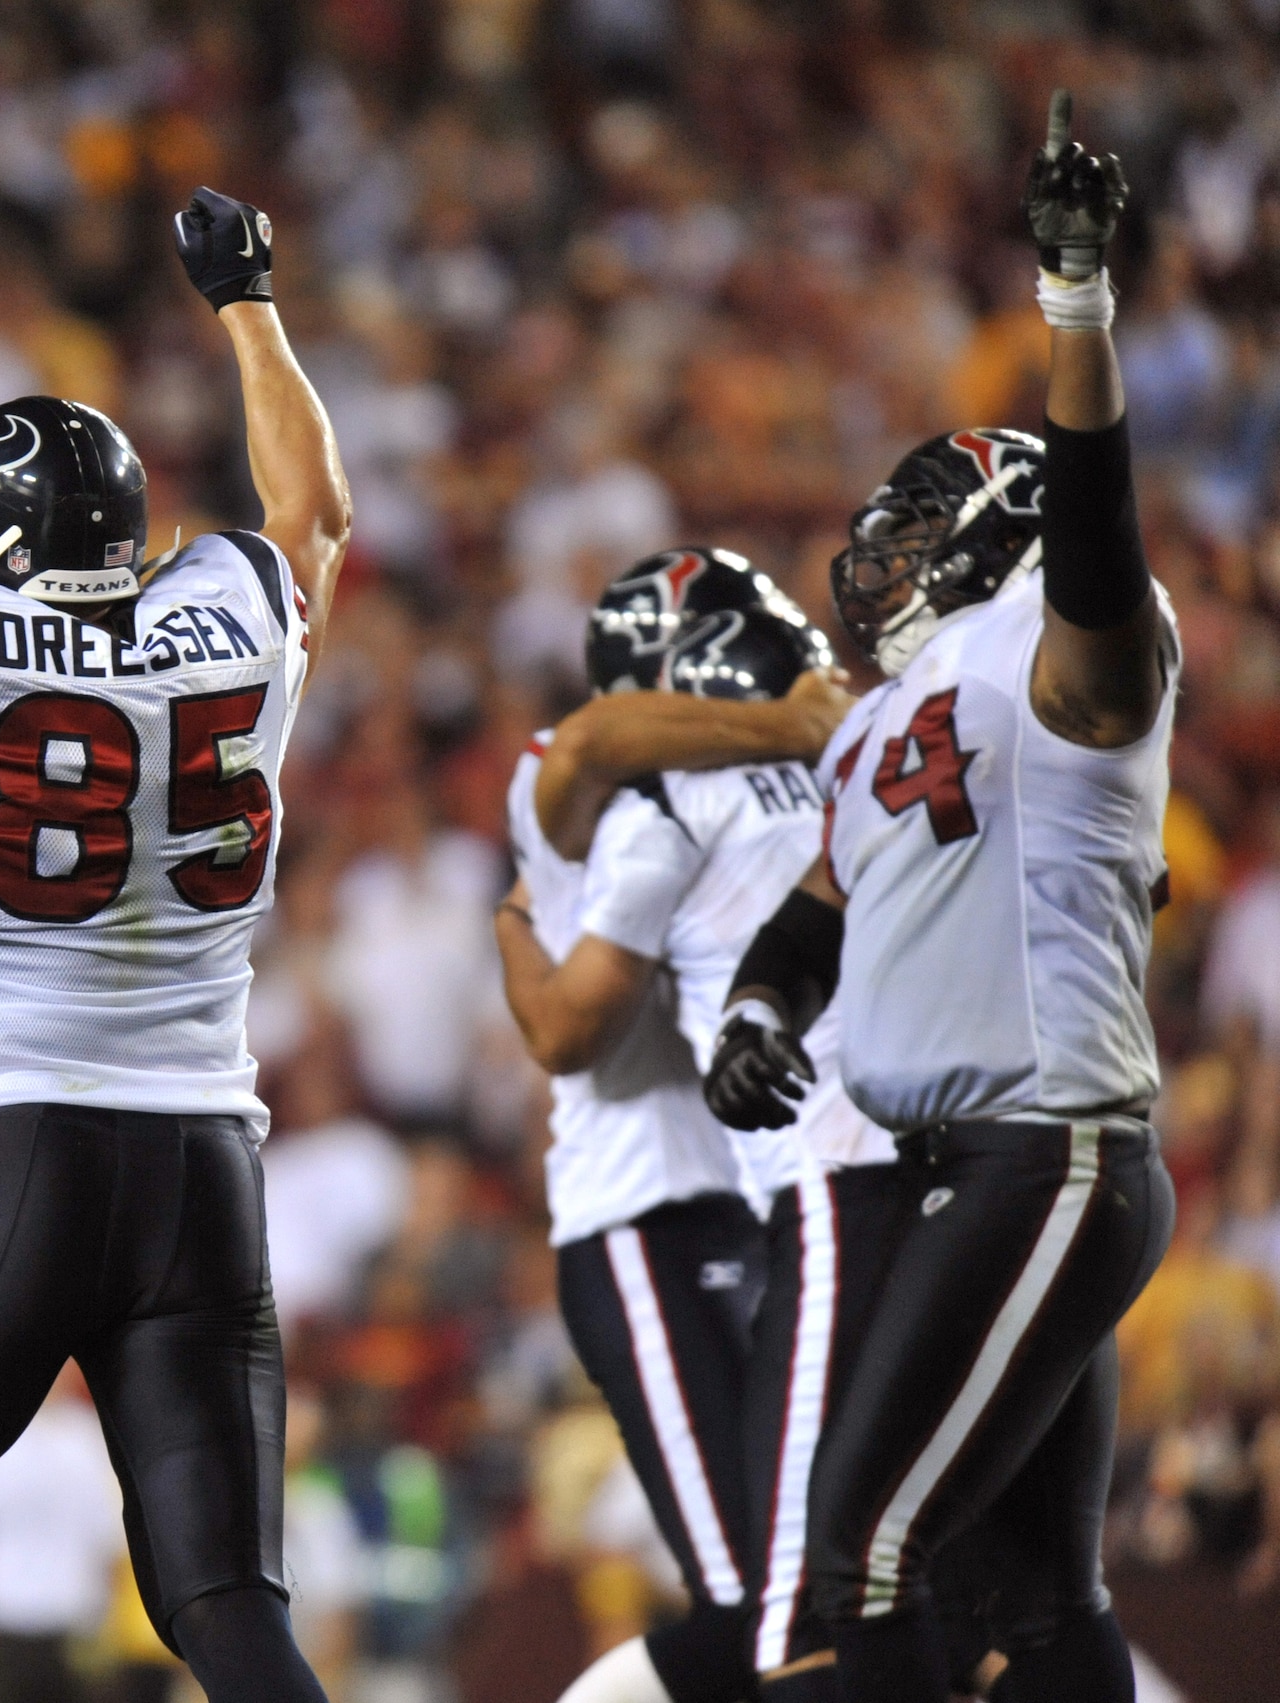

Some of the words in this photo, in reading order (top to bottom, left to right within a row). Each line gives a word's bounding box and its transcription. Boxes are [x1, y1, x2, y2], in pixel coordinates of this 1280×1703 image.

[11, 557, 27, 569] NFL
[39, 578, 130, 593] TEXANS
[744, 764, 825, 815] RA
